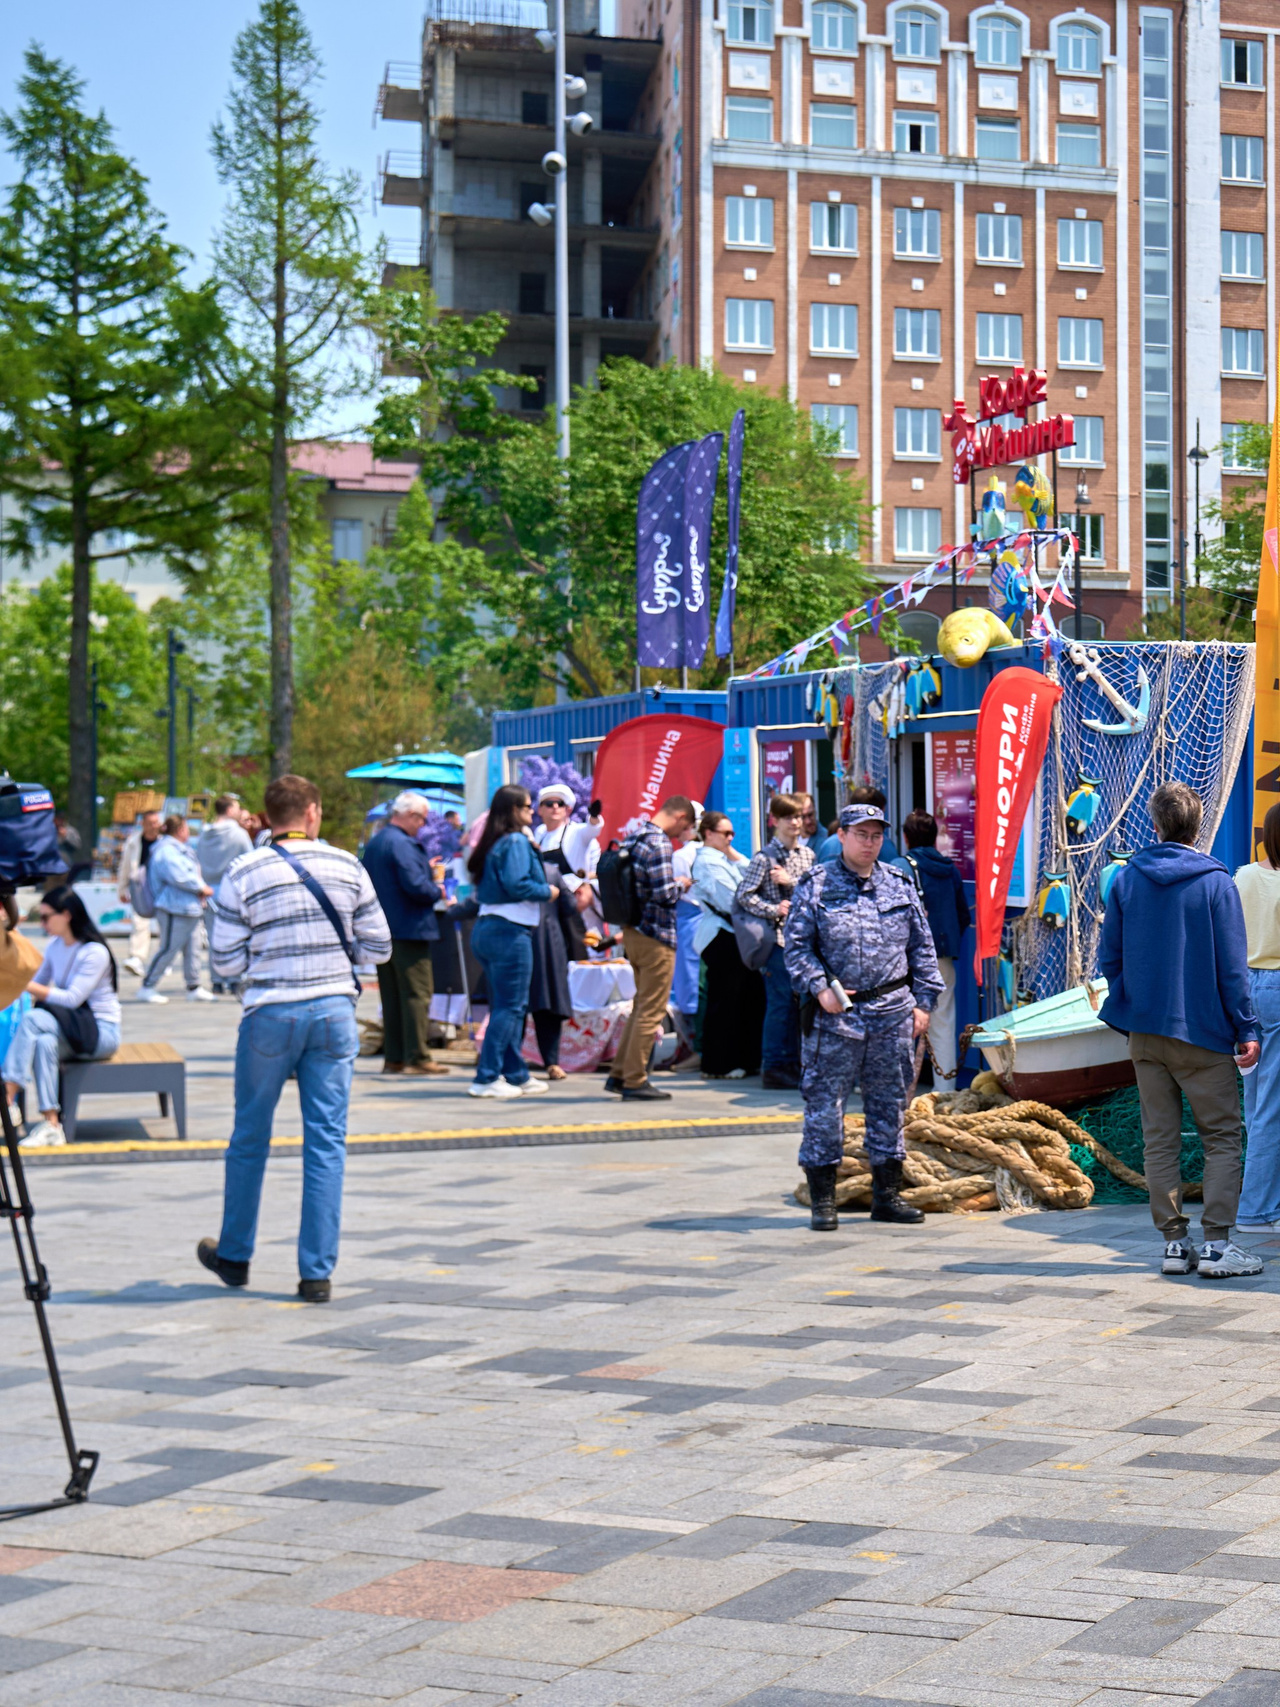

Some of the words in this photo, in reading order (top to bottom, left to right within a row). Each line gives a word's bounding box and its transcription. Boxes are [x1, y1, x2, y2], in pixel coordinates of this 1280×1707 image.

[979, 365, 1047, 420] Кофе
[979, 413, 1075, 468] Машина
[638, 729, 682, 811] Машина
